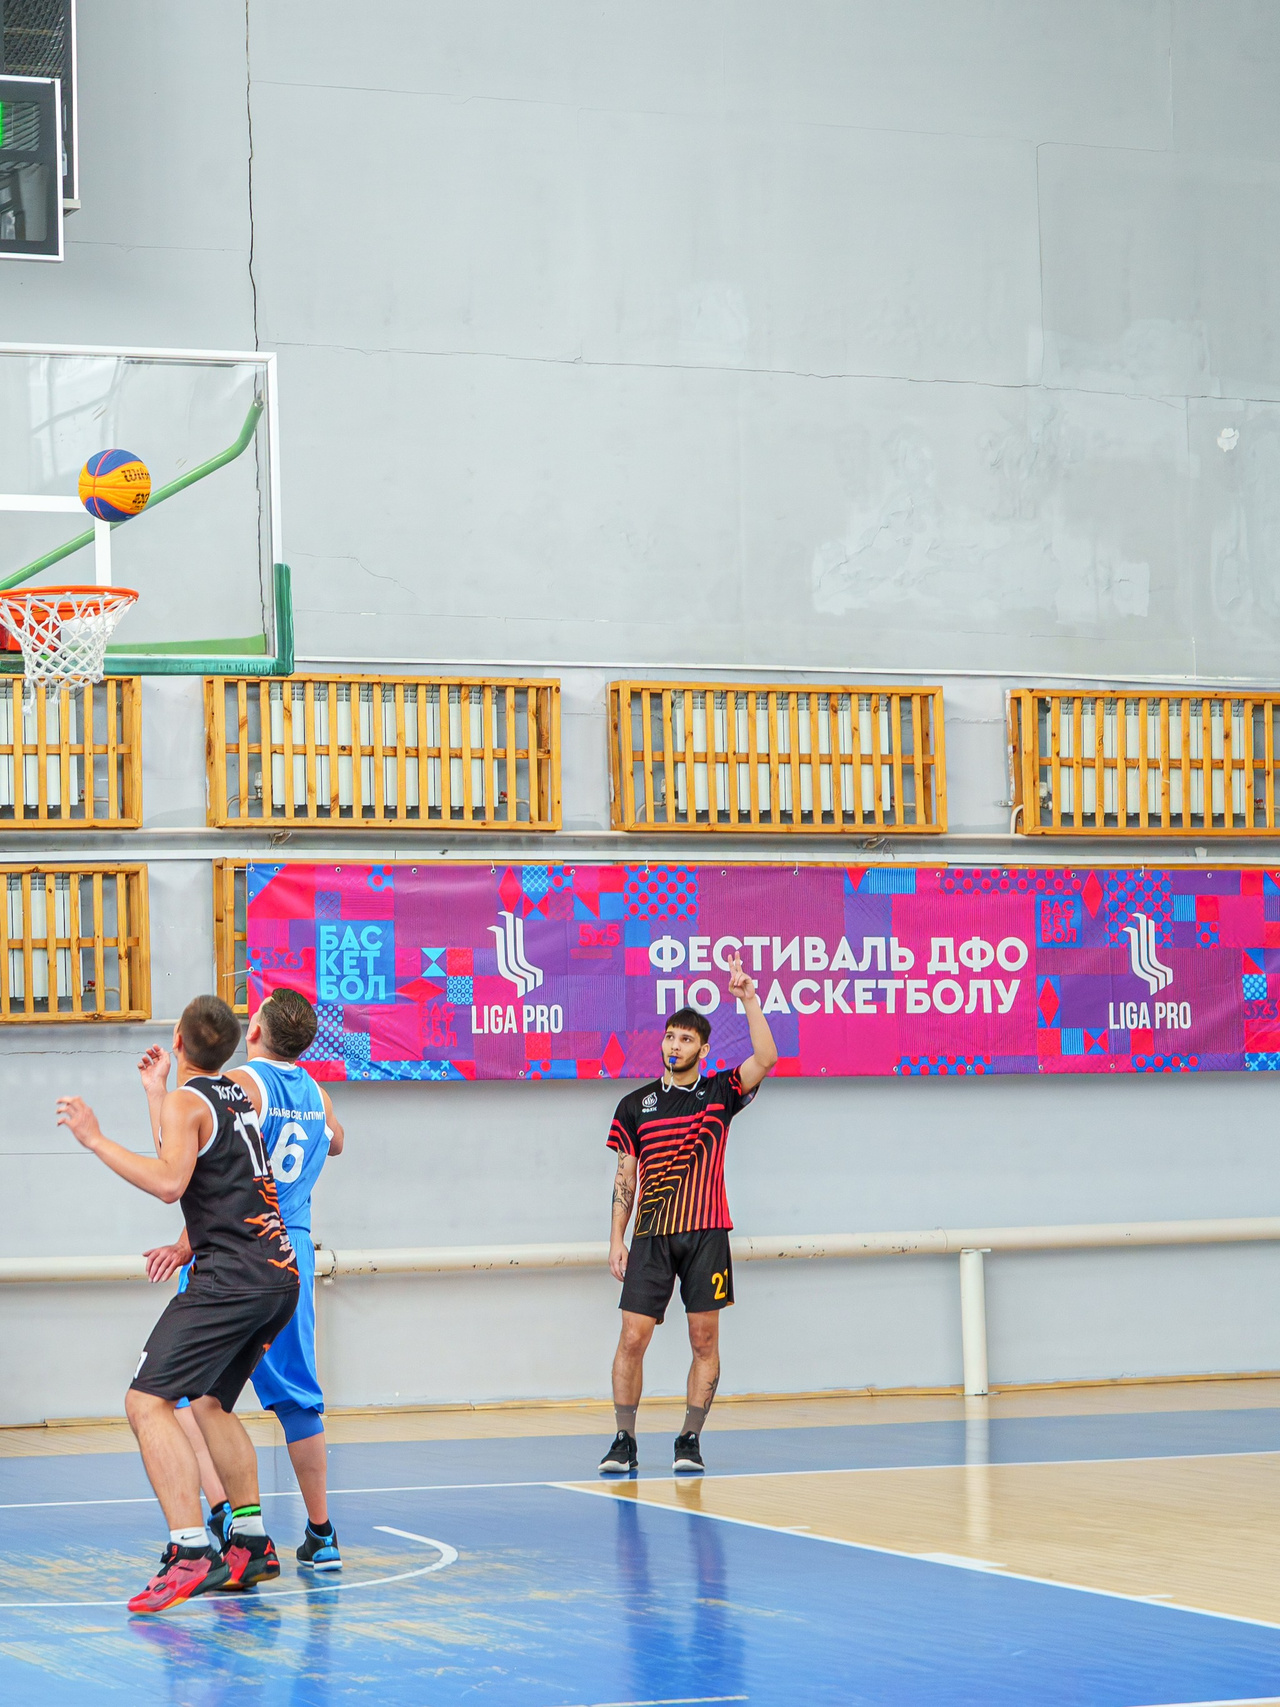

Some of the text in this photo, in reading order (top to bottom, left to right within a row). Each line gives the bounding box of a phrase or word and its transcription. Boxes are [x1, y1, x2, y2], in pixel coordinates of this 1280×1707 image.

[1041, 900, 1075, 915] БАС
[578, 923, 621, 947] 5x5
[1041, 914, 1073, 930] КЕТ
[320, 925, 384, 951] БАС
[1042, 928, 1077, 943] БОЛ
[320, 950, 381, 976] КЕТ
[648, 935, 1029, 975] ФЕСТИВАЛЬ ДФО
[321, 975, 386, 1001] БОЛ
[655, 979, 721, 1016] ПО
[471, 1004, 564, 1035] LIGA PRO
[1108, 1001, 1192, 1030] LIGA PRO
[271, 1121, 308, 1184] 6
